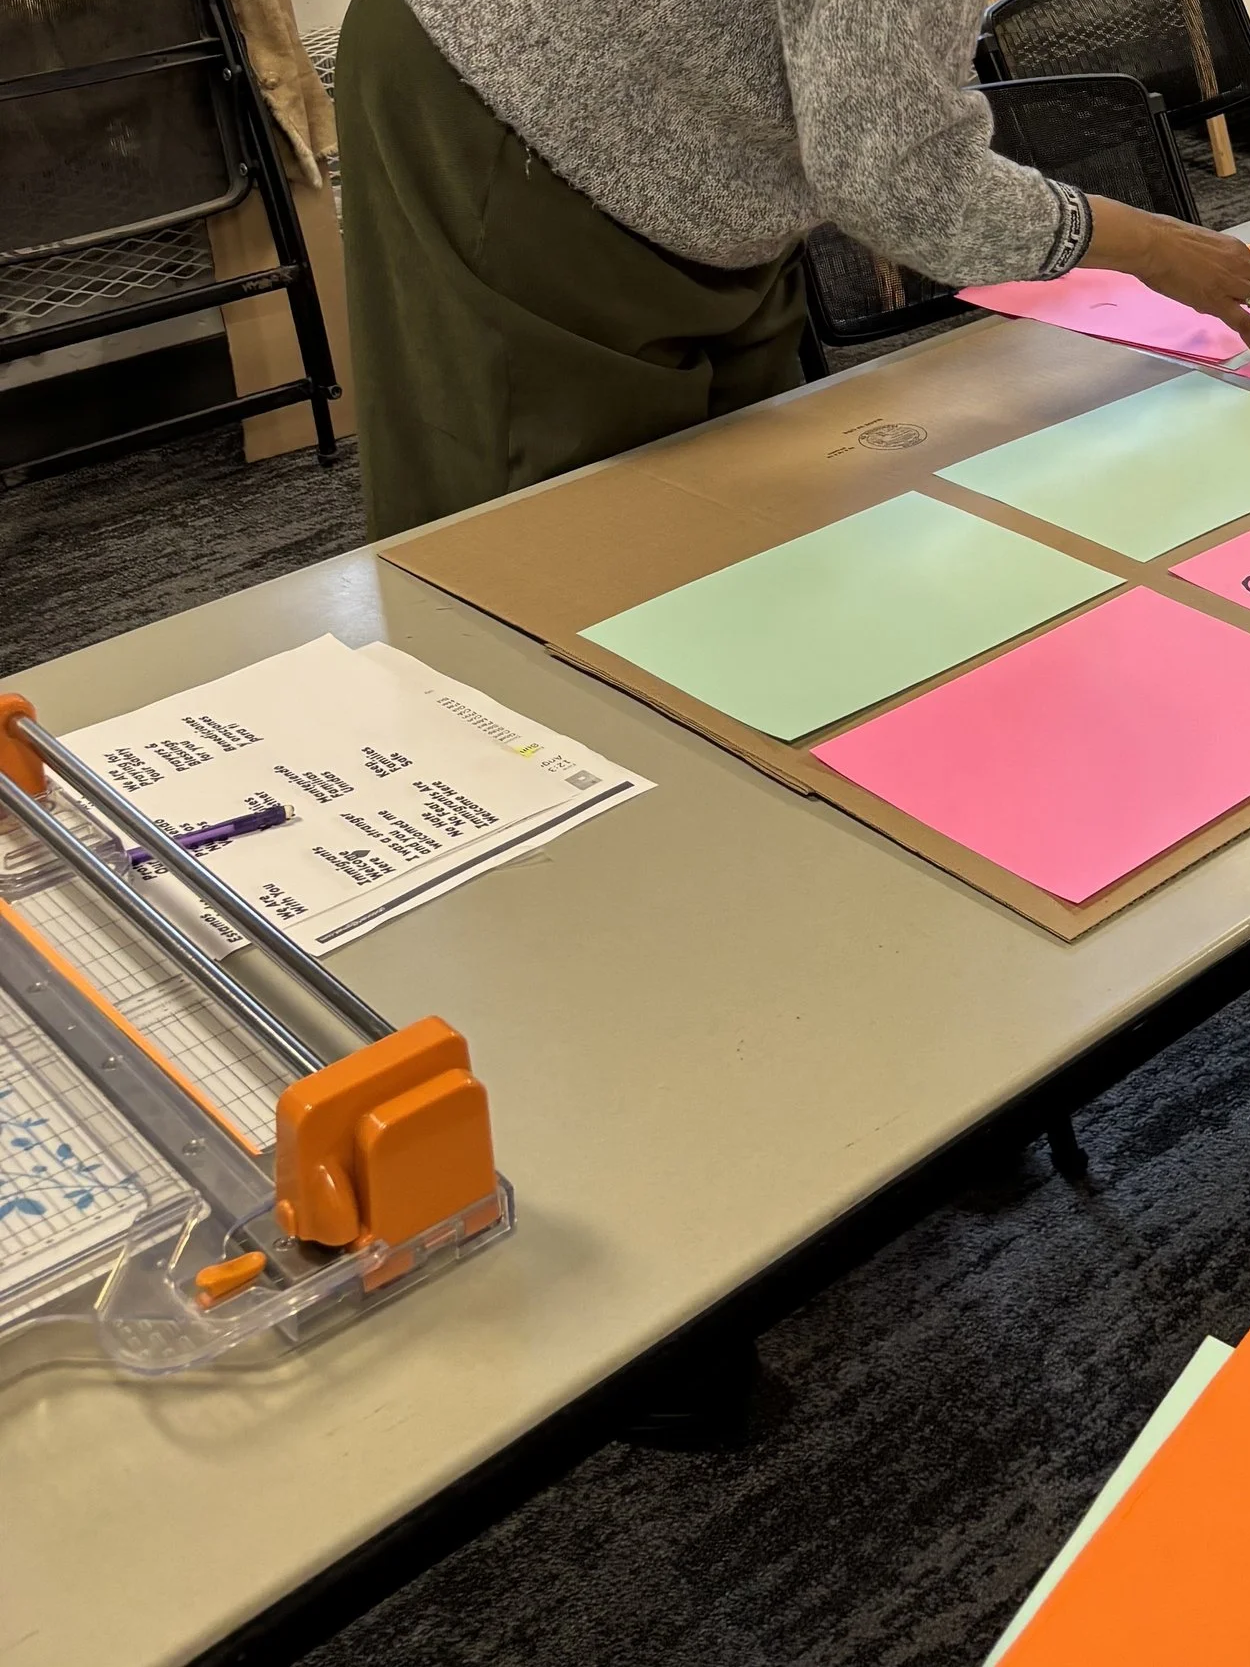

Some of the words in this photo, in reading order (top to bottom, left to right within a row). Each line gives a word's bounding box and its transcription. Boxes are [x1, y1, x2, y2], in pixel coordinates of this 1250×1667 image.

[236, 729, 264, 742] para
[161, 740, 201, 766] Blessings
[180, 741, 204, 752] you
[104, 753, 118, 763] for
[154, 749, 190, 772] Prayers
[196, 752, 214, 761] for
[361, 747, 402, 772] Families
[390, 753, 413, 767] Safe
[108, 770, 124, 782] Are
[117, 762, 156, 787] Praying
[144, 767, 164, 782] Your
[365, 760, 390, 778] Keep
[122, 780, 141, 793] We
[274, 766, 334, 803] Manteniendo
[302, 772, 344, 798] Familias
[321, 772, 354, 793] Unidas
[412, 781, 433, 792] Are
[428, 781, 457, 798] Here
[378, 811, 397, 820] me
[424, 802, 450, 817] Fear
[429, 790, 492, 829] Immigrants
[455, 796, 499, 824] Welcome
[340, 813, 383, 838] stranger
[422, 812, 448, 828] Hate
[448, 816, 466, 826] No
[389, 830, 415, 843] you
[390, 820, 442, 851] welcomed
[445, 827, 464, 837] No
[388, 843, 411, 856] was
[406, 842, 431, 854] and
[312, 847, 374, 886] Immigrants
[339, 851, 383, 880] Welcome
[369, 857, 396, 874] Here
[263, 884, 284, 898] You
[259, 895, 279, 908] Are
[282, 896, 309, 914] With
[277, 908, 296, 920] We
[200, 914, 243, 943] Estamos
